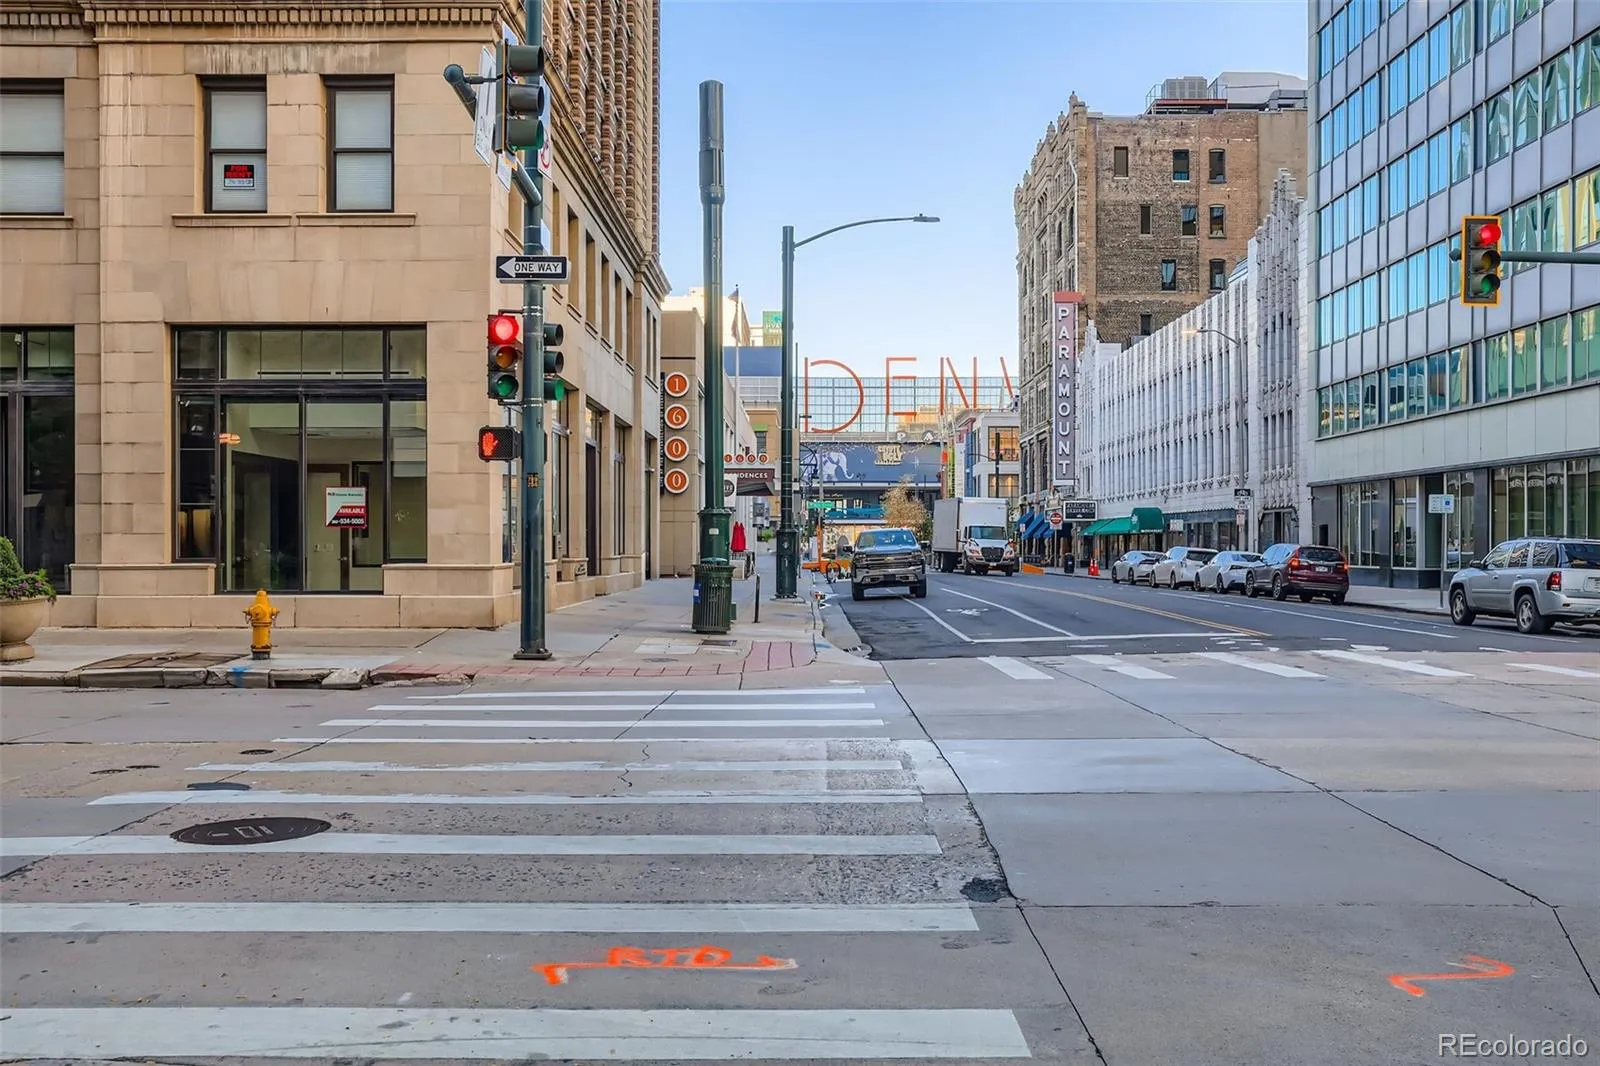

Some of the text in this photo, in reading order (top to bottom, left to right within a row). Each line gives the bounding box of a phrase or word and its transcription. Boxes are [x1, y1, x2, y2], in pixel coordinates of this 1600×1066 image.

[514, 263, 559, 272] ONE WAY
[1058, 306, 1071, 475] PARAMOUNT
